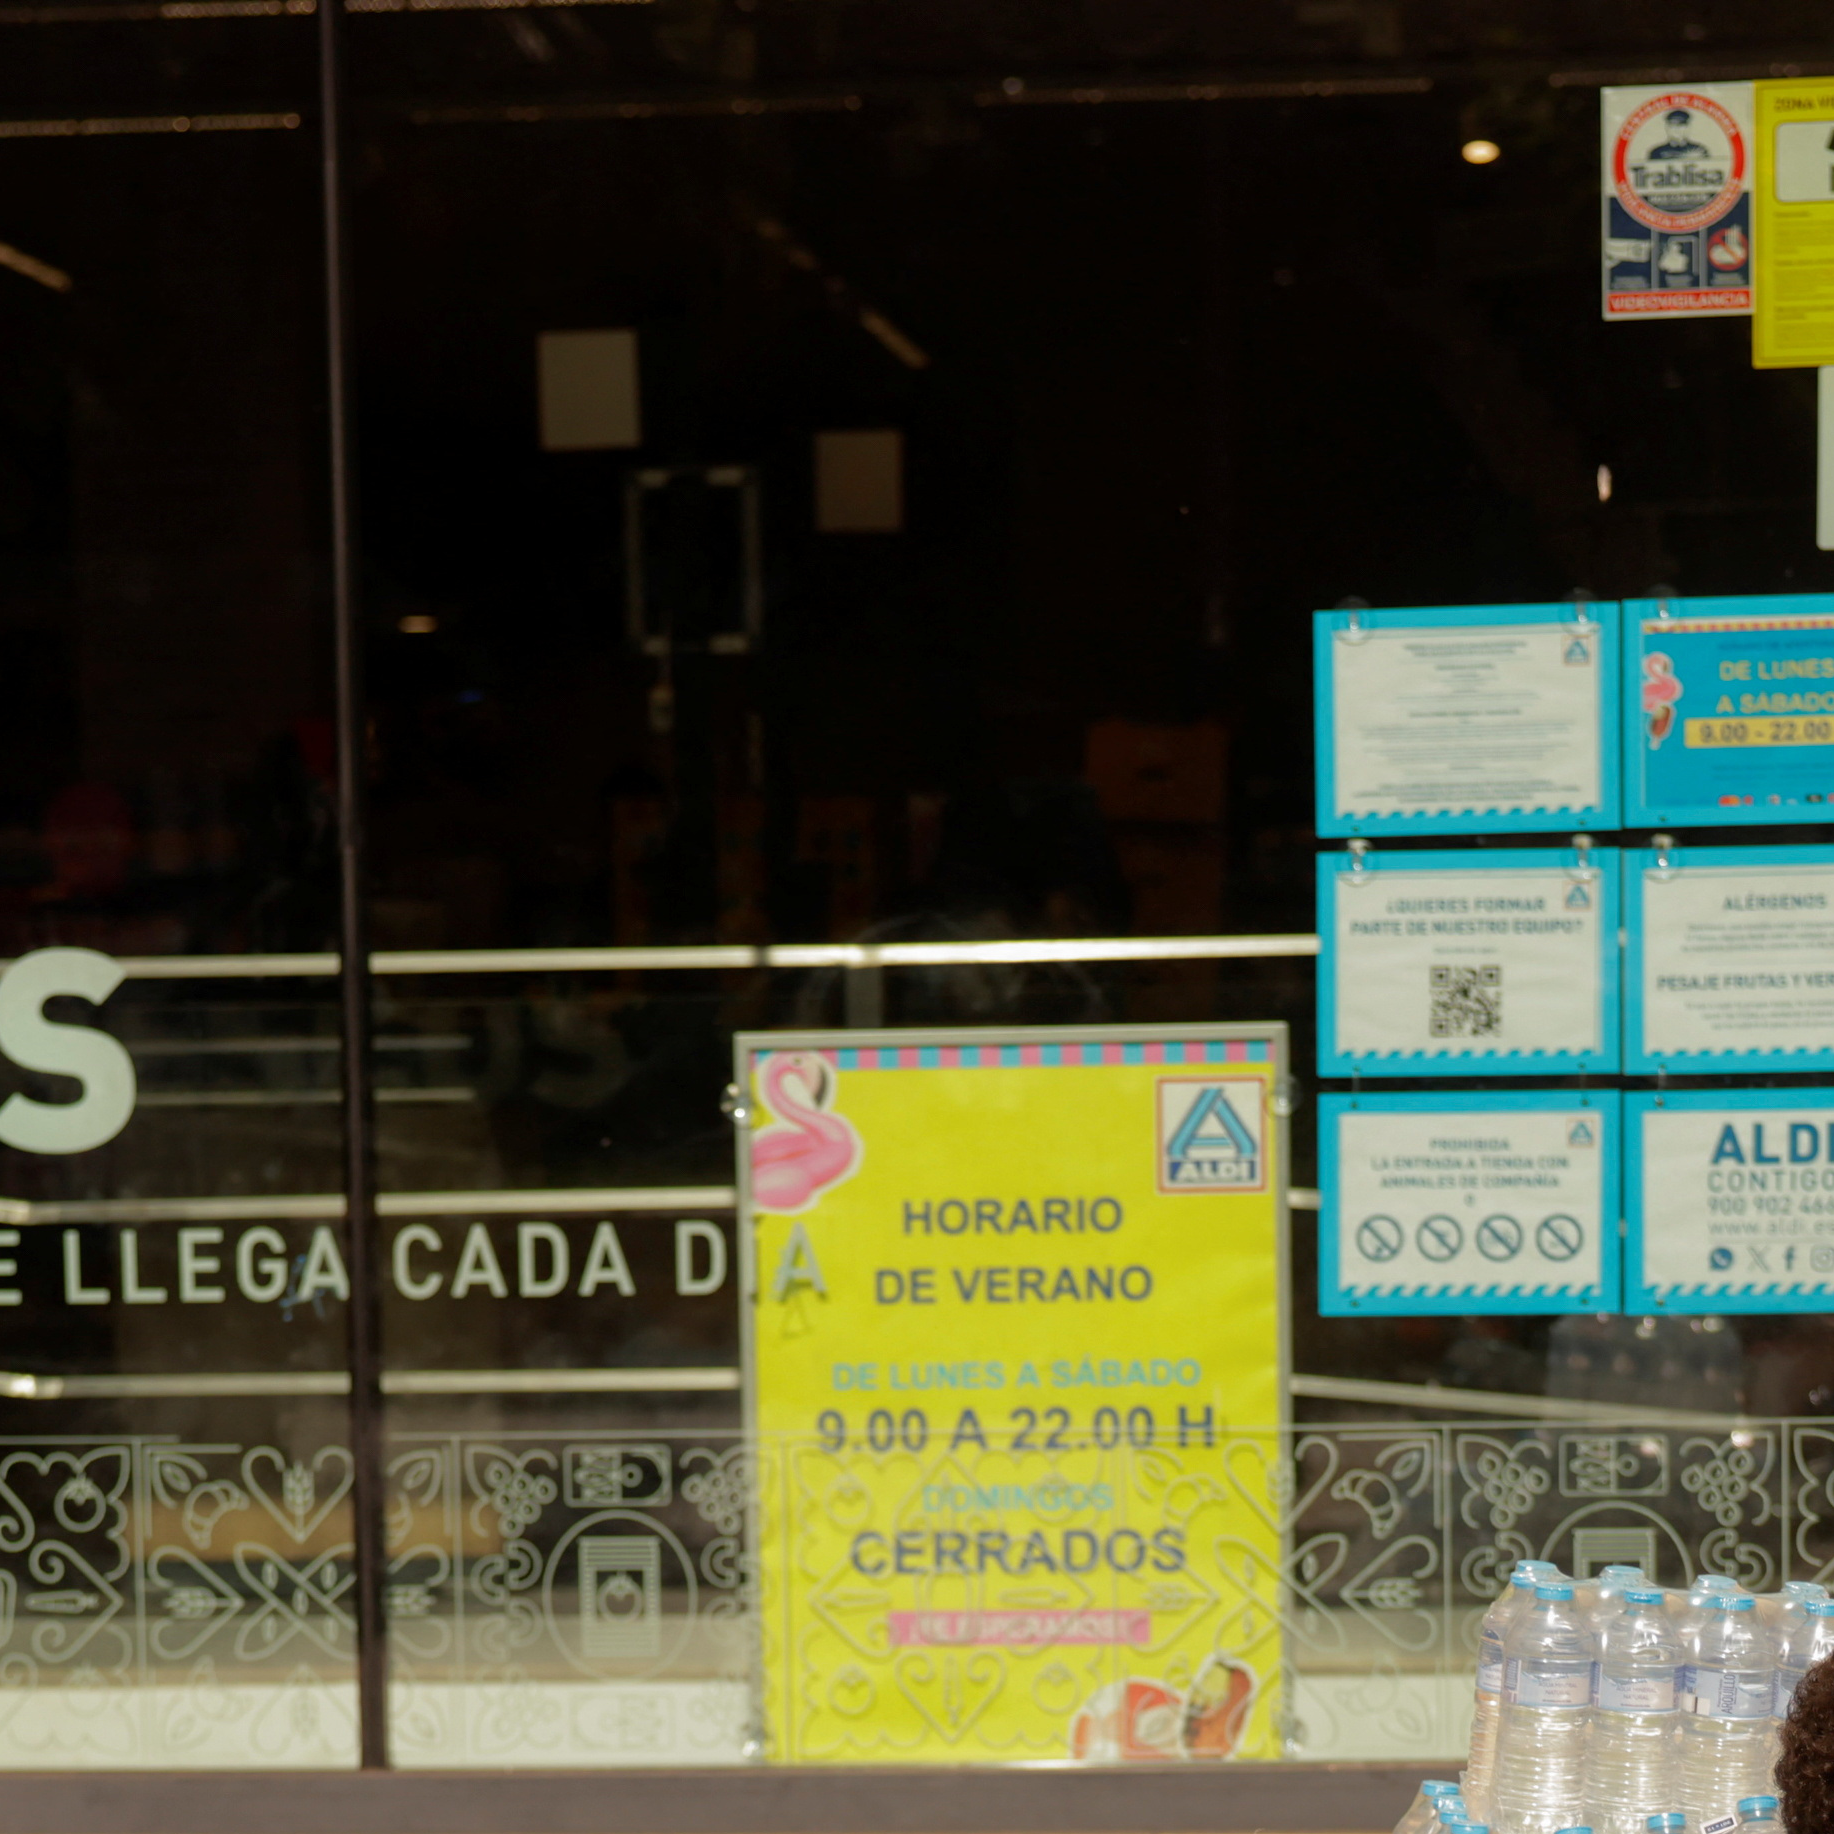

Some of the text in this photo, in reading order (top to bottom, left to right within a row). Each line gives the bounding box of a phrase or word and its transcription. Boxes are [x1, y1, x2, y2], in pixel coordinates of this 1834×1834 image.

[1630, 163, 1724, 189] Trablisa
[1719, 659, 1752, 681] DE
[1716, 695, 1735, 714] A
[1699, 722, 1749, 743] 9.00
[1768, 720, 1832, 742] 22.00
[1473, 896, 1546, 913] FORMAR
[1349, 919, 1403, 937] PARTE
[1406, 918, 1428, 936] DE
[1431, 917, 1509, 936] NUESTRO
[1656, 973, 1719, 992] PESAJE
[1722, 971, 1789, 990] FRUTAS
[1791, 973, 1804, 989] Y
[1173, 1159, 1254, 1182] ALDI
[902, 1196, 1124, 1236] HORARIO
[62, 1225, 351, 1306] LLEGA
[391, 1221, 637, 1301] CADA
[875, 1264, 1154, 1305] DE VERANO
[832, 1361, 883, 1391] DE
[888, 1359, 1006, 1391] LUNES
[1016, 1360, 1042, 1389] A
[817, 1405, 1215, 1455] 9.00 A 22.00 H
[921, 1483, 1116, 1514] DOMINGOS
[850, 1527, 1187, 1576] CERRADOS
